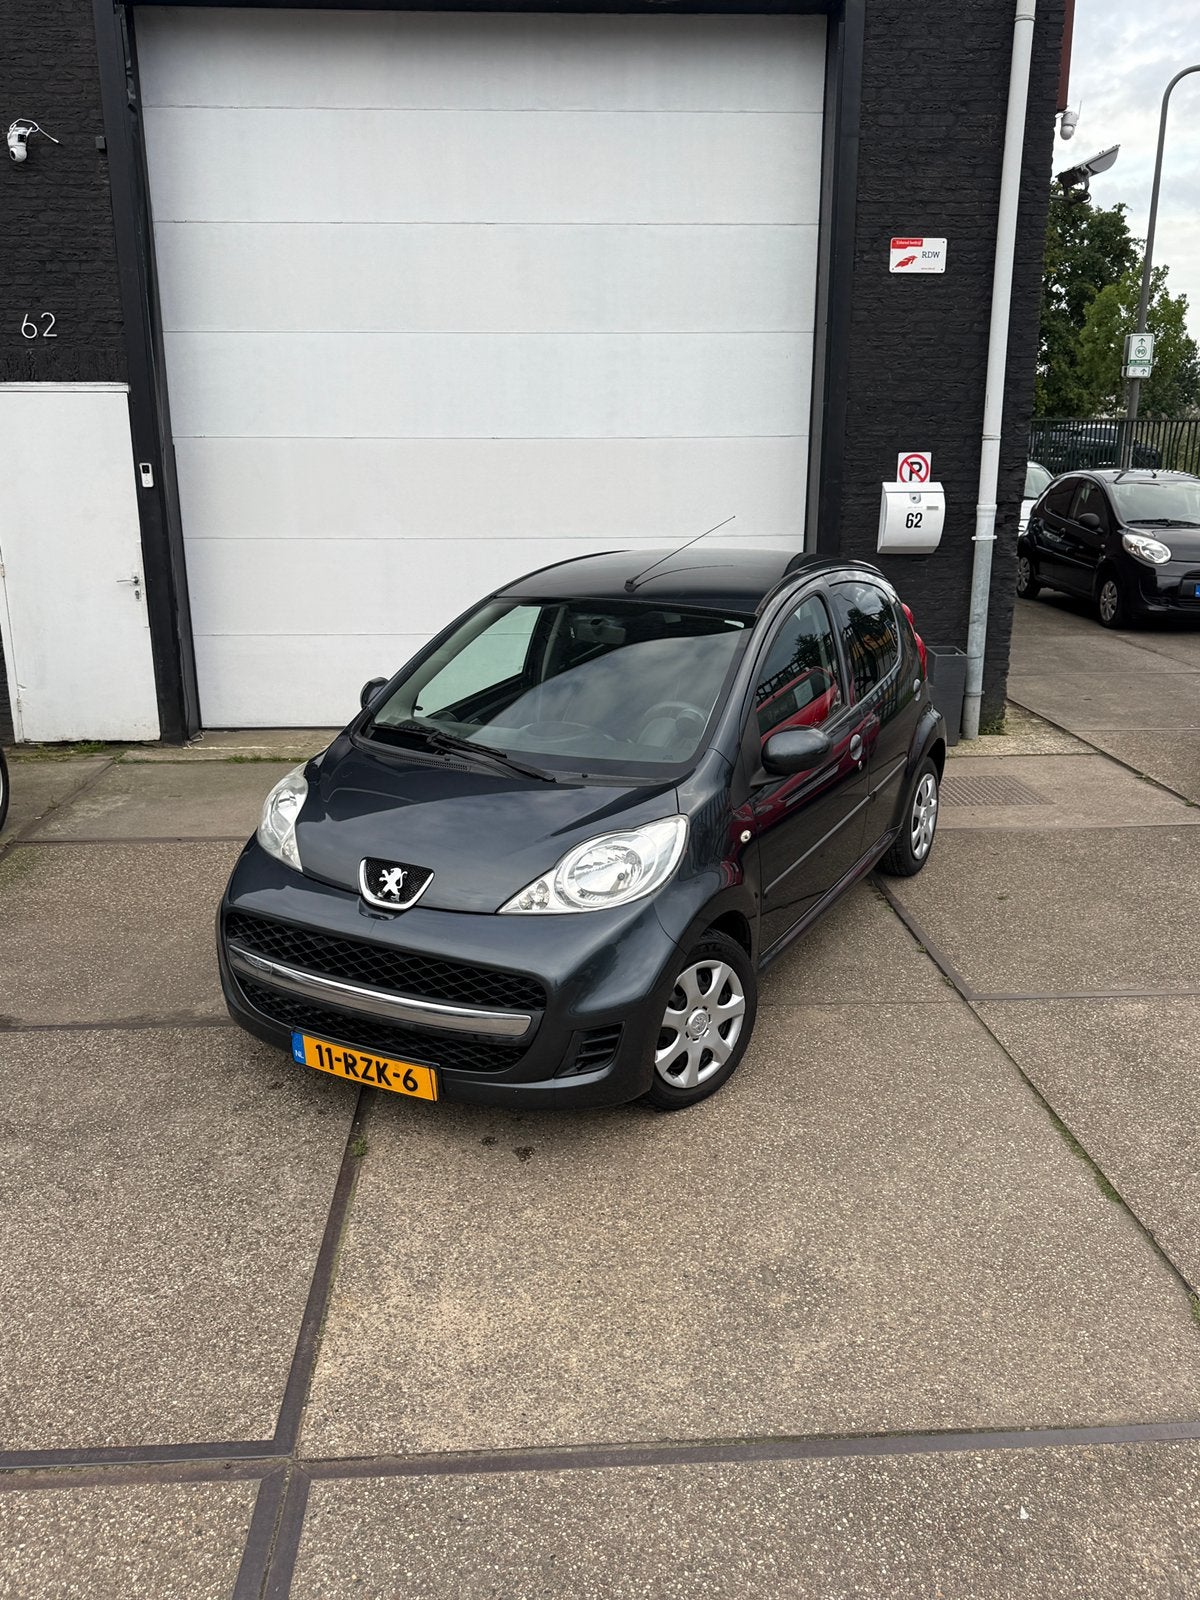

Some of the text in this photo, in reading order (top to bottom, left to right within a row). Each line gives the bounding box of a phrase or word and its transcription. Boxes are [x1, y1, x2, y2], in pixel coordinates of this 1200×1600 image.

[921, 251, 941, 259] RDW
[21, 312, 57, 339] 62
[909, 461, 923, 482] P
[905, 512, 923, 529] 62
[295, 1050, 304, 1059] NL
[315, 1044, 419, 1092] 11-RZK-6
